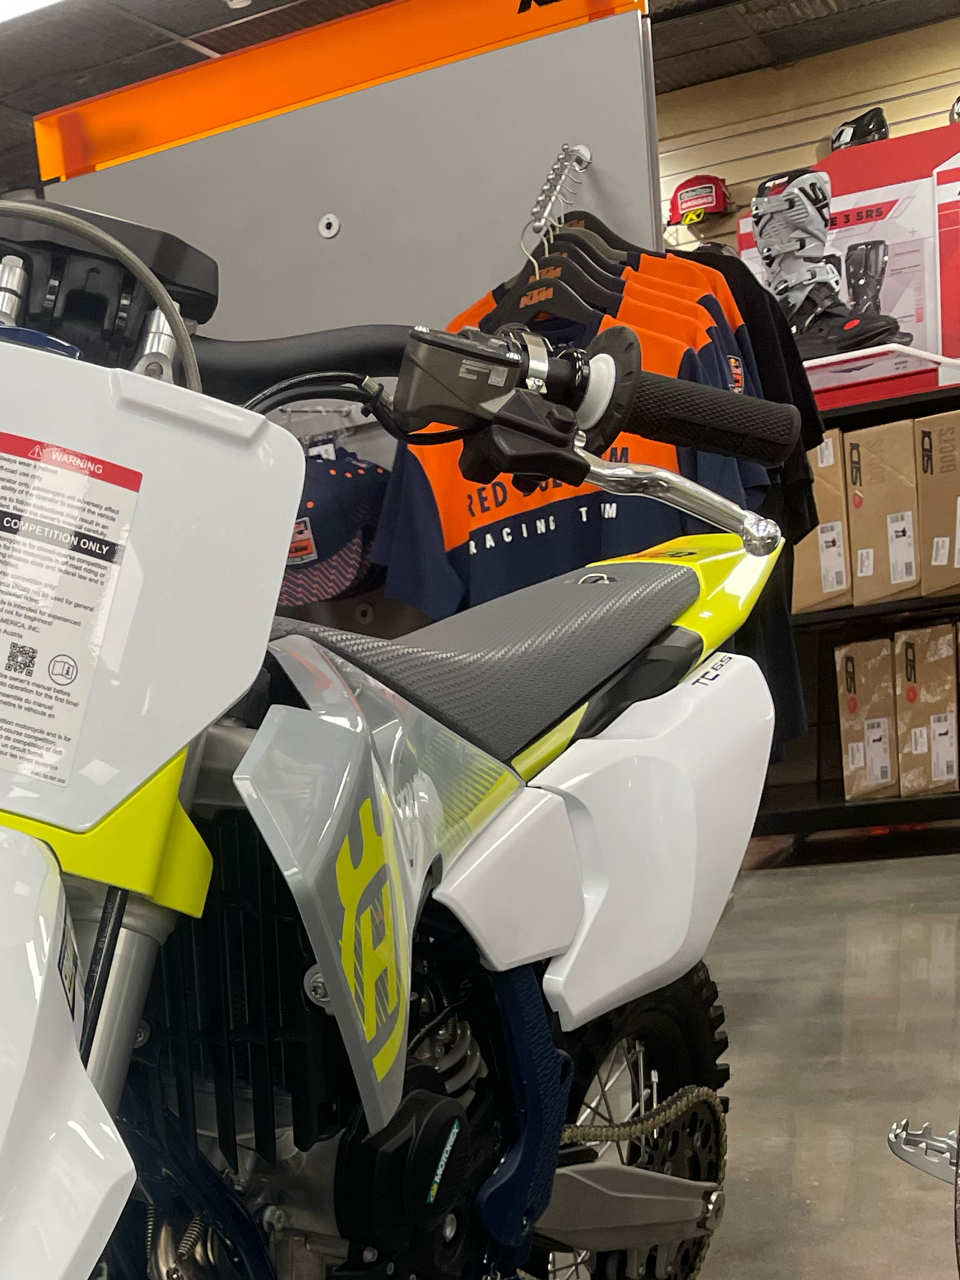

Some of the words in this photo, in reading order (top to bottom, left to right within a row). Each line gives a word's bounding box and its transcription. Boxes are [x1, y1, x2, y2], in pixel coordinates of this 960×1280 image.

[855, 207, 883, 221] SRS
[519, 287, 554, 308] KTM
[51, 451, 103, 474] WARNING
[2, 515, 78, 546] COMPETITION
[79, 538, 109, 555] ONLY
[469, 516, 556, 555] RACING
